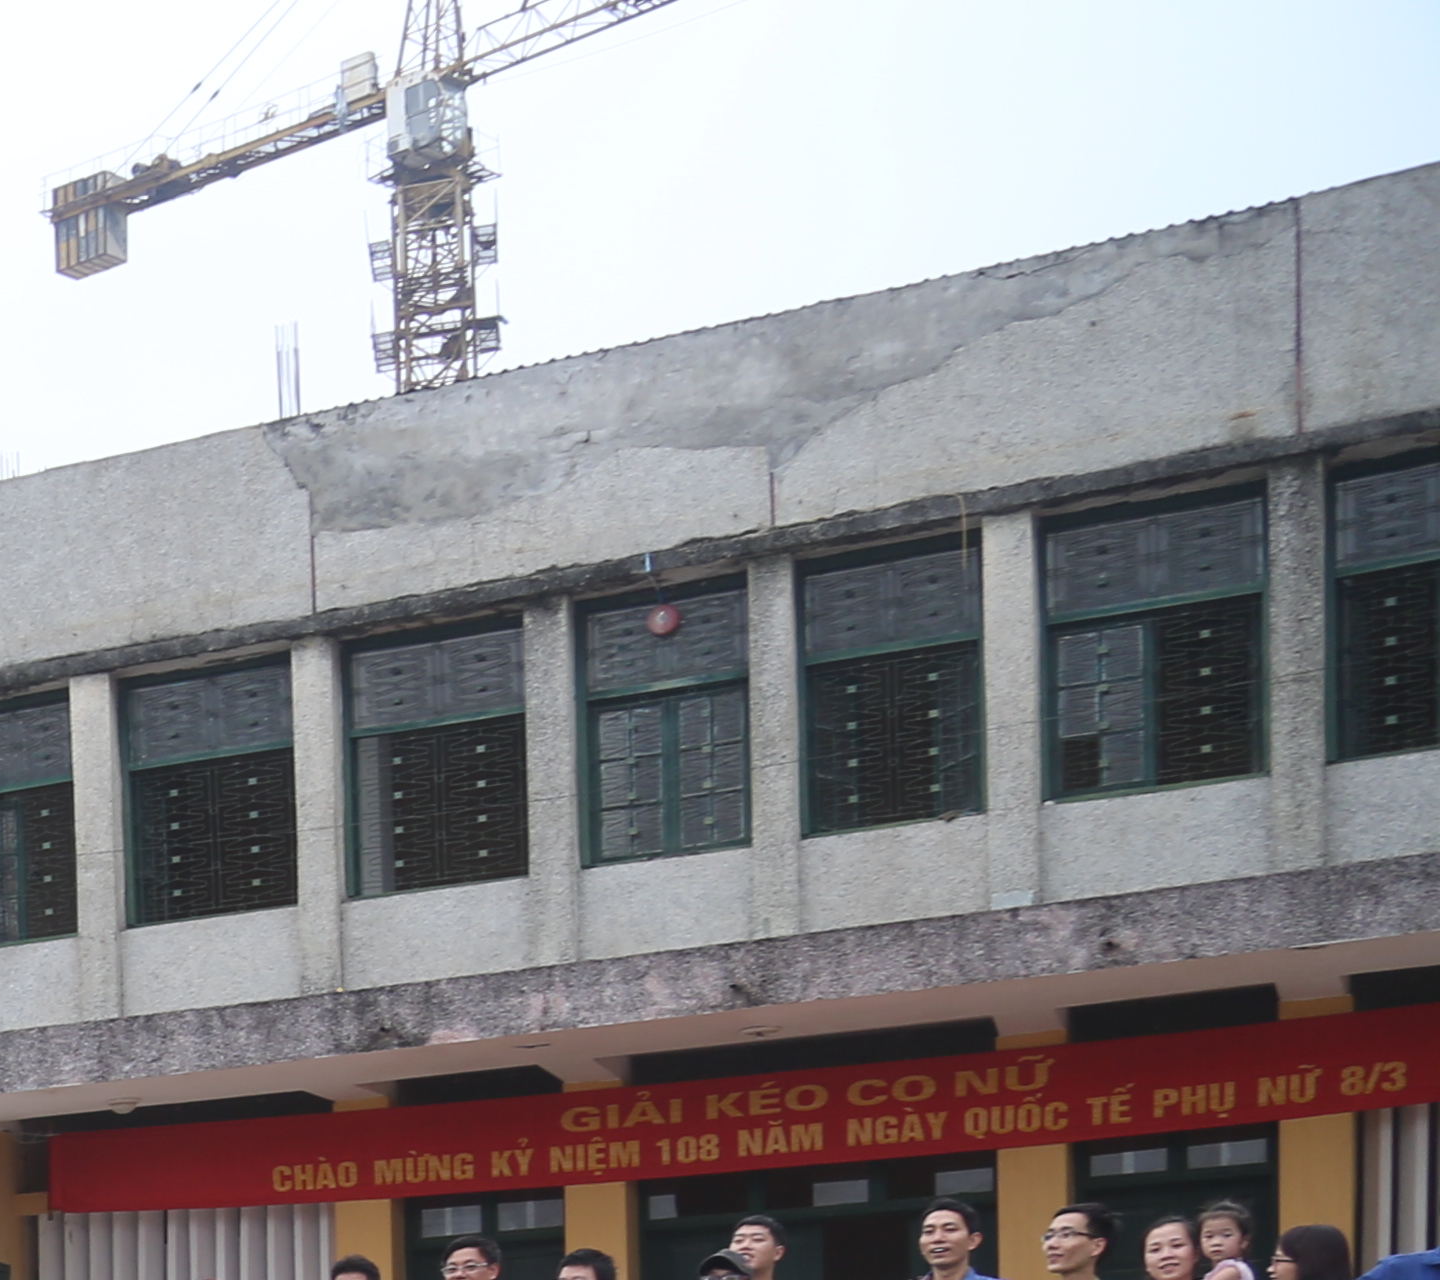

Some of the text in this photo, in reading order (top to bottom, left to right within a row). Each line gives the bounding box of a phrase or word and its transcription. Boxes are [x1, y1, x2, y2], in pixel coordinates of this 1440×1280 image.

[272, 1061, 1408, 1192] CHÀO MỪNG KỶ NIỆM 108 NĂM NGÀY QUỐC TẾ PHỤ NỮ 8/3
[560, 1054, 1056, 1132] GIẢI KÉO CO NỮ
